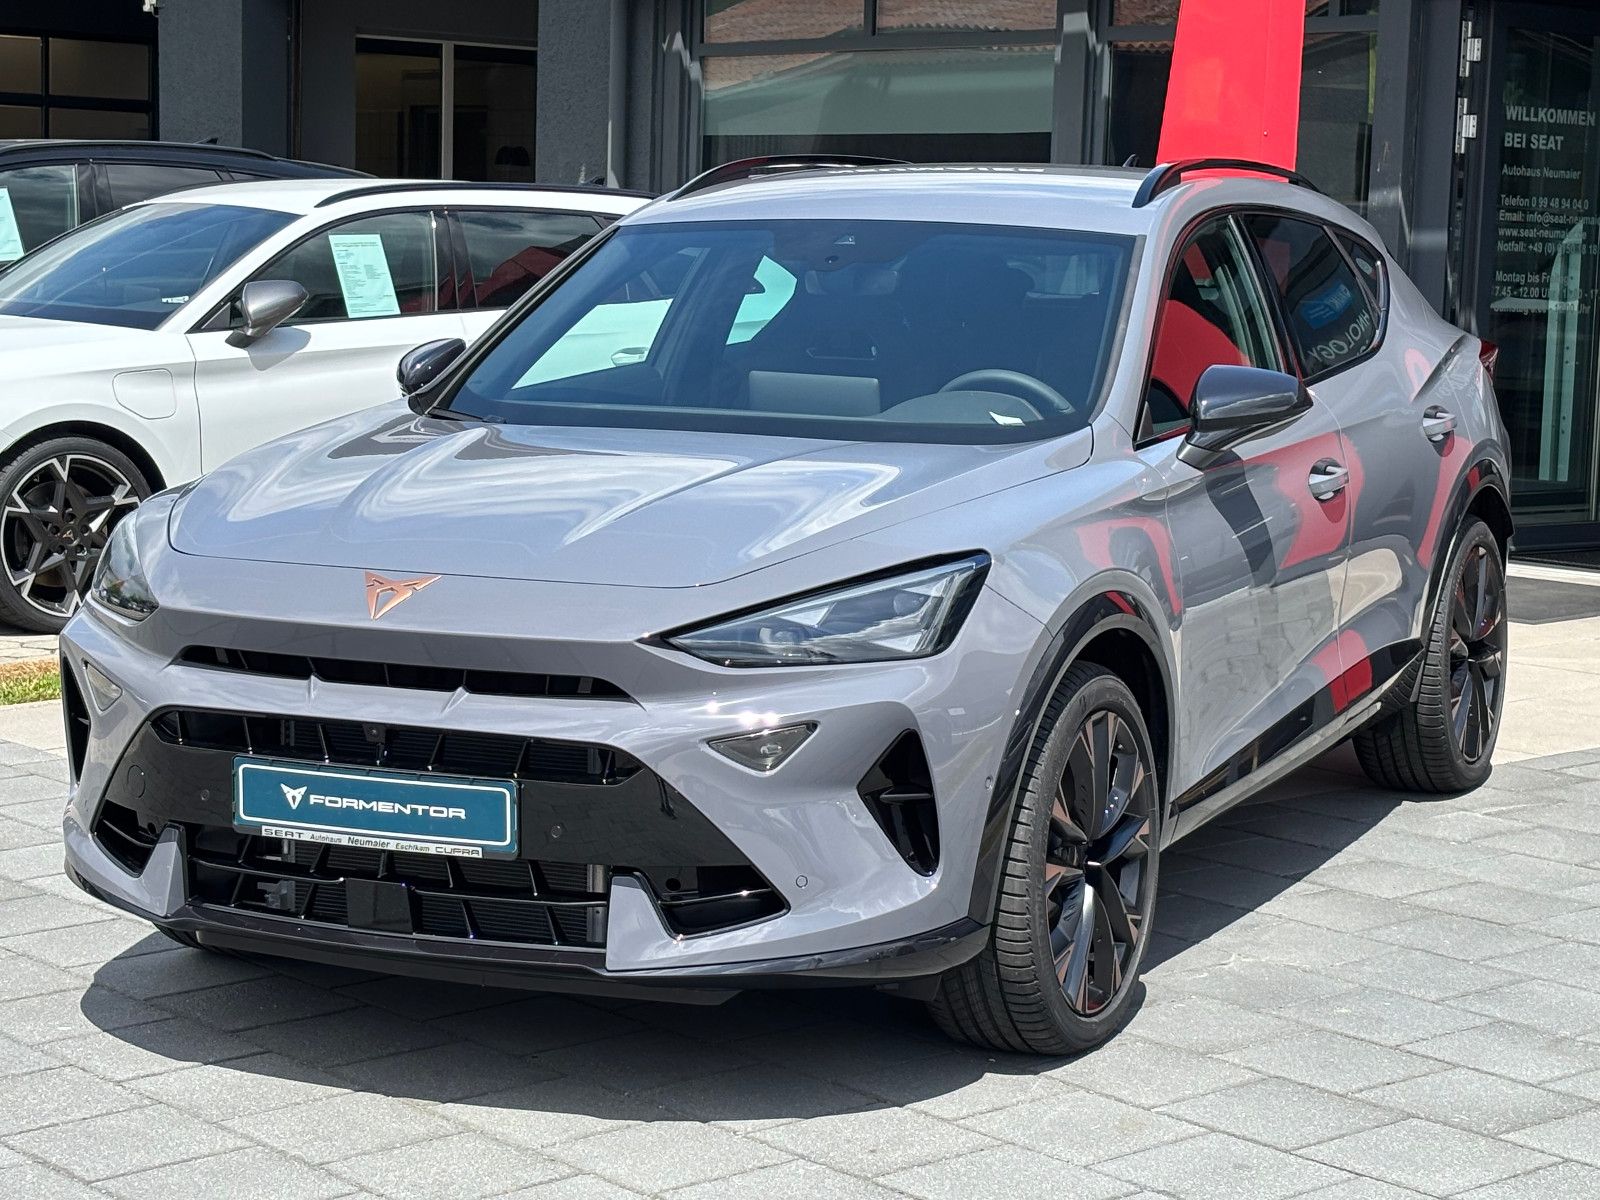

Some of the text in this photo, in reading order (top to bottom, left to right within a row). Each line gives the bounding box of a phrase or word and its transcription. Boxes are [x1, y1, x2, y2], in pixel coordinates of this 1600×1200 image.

[1506, 106, 1596, 126] WILLKOMMEN
[1504, 132, 1564, 151] BEI SEAT
[1501, 164, 1582, 179] Autohaus Neumaier
[1501, 194, 1529, 207] Telefon
[1531, 196, 1537, 208] 0
[1538, 197, 1548, 208] 99
[1550, 197, 1560, 209] 48
[1561, 198, 1571, 209] 94
[1499, 209, 1525, 222] Email:
[1497, 240, 1525, 253] Notfall:
[1527, 242, 1543, 254] +49
[1544, 242, 1555, 256] (0)
[1495, 270, 1526, 285] Montag
[1527, 272, 1540, 283] bis
[1495, 286, 1512, 298] 7.45
[1519, 287, 1540, 299] 12.00
[309, 794, 467, 820] FORMENTOR
[264, 828, 305, 839] SEAT
[309, 833, 343, 845] Autohaus
[347, 836, 391, 850] Neumaier
[435, 846, 481, 857] CUPRA
